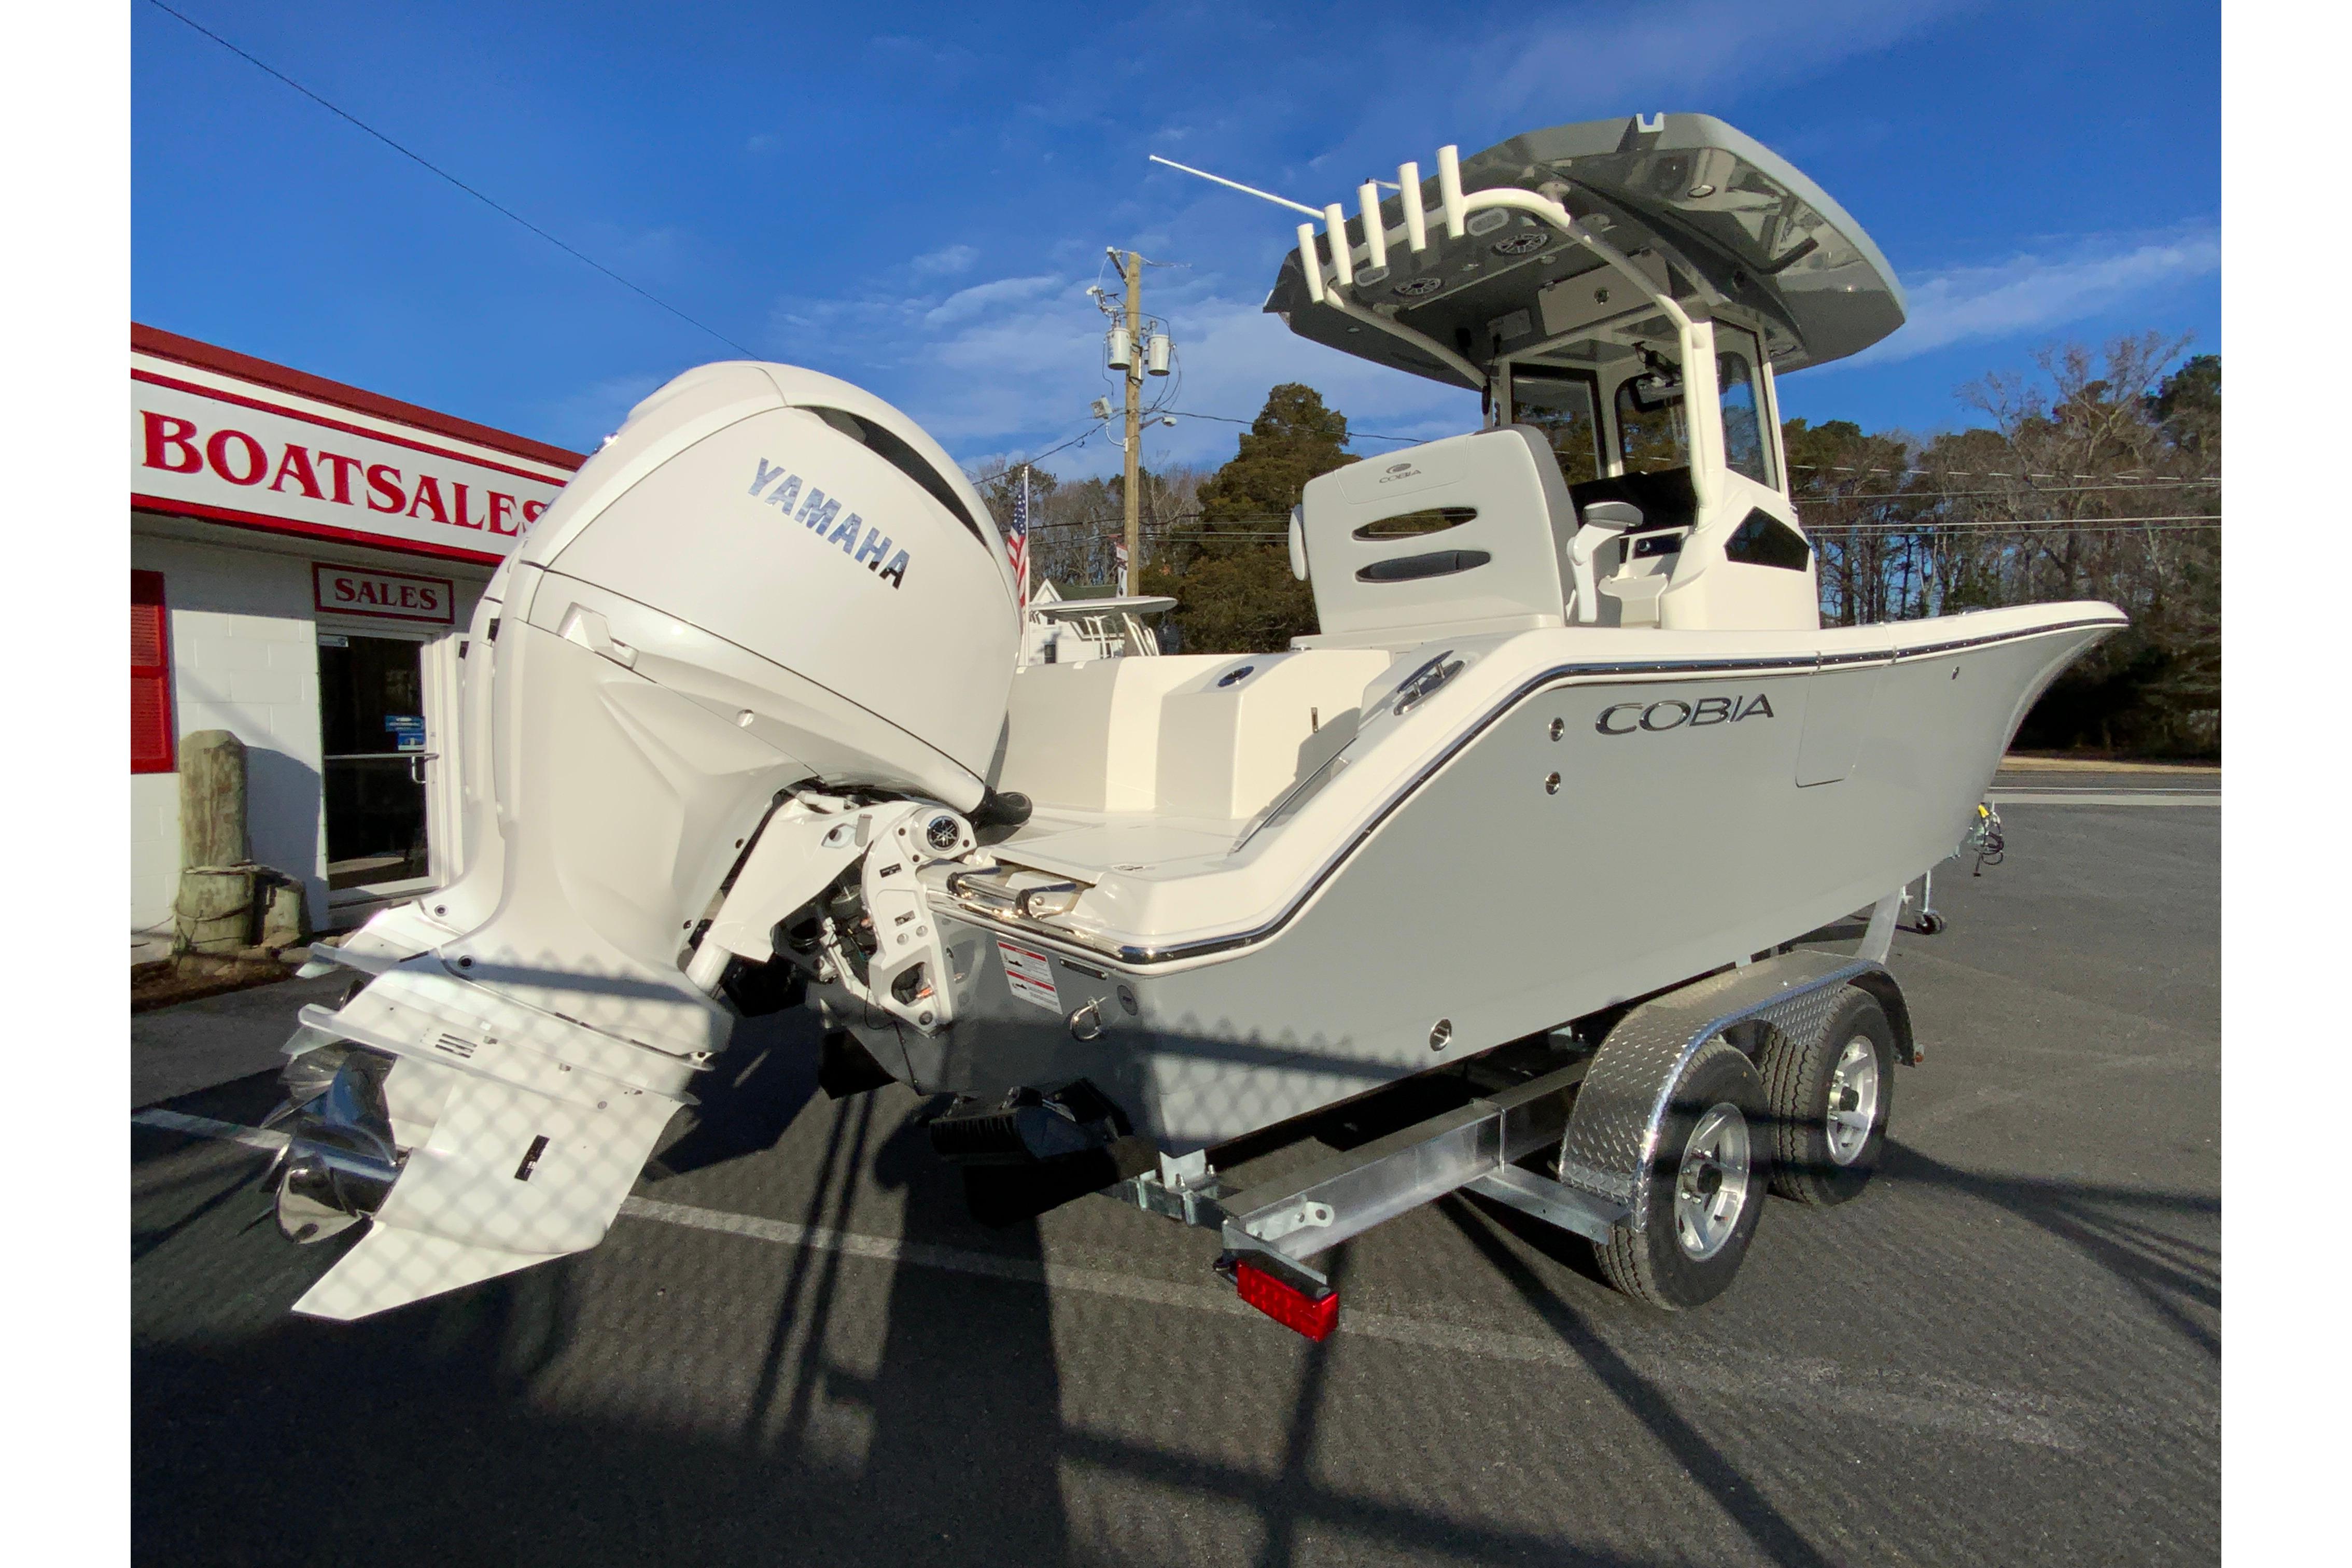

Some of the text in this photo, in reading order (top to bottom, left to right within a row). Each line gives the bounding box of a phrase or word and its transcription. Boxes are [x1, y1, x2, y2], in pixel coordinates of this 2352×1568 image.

[748, 457, 910, 590] YAMAHA
[334, 578, 438, 611] SALES
[1595, 693, 1774, 736] COBIA
